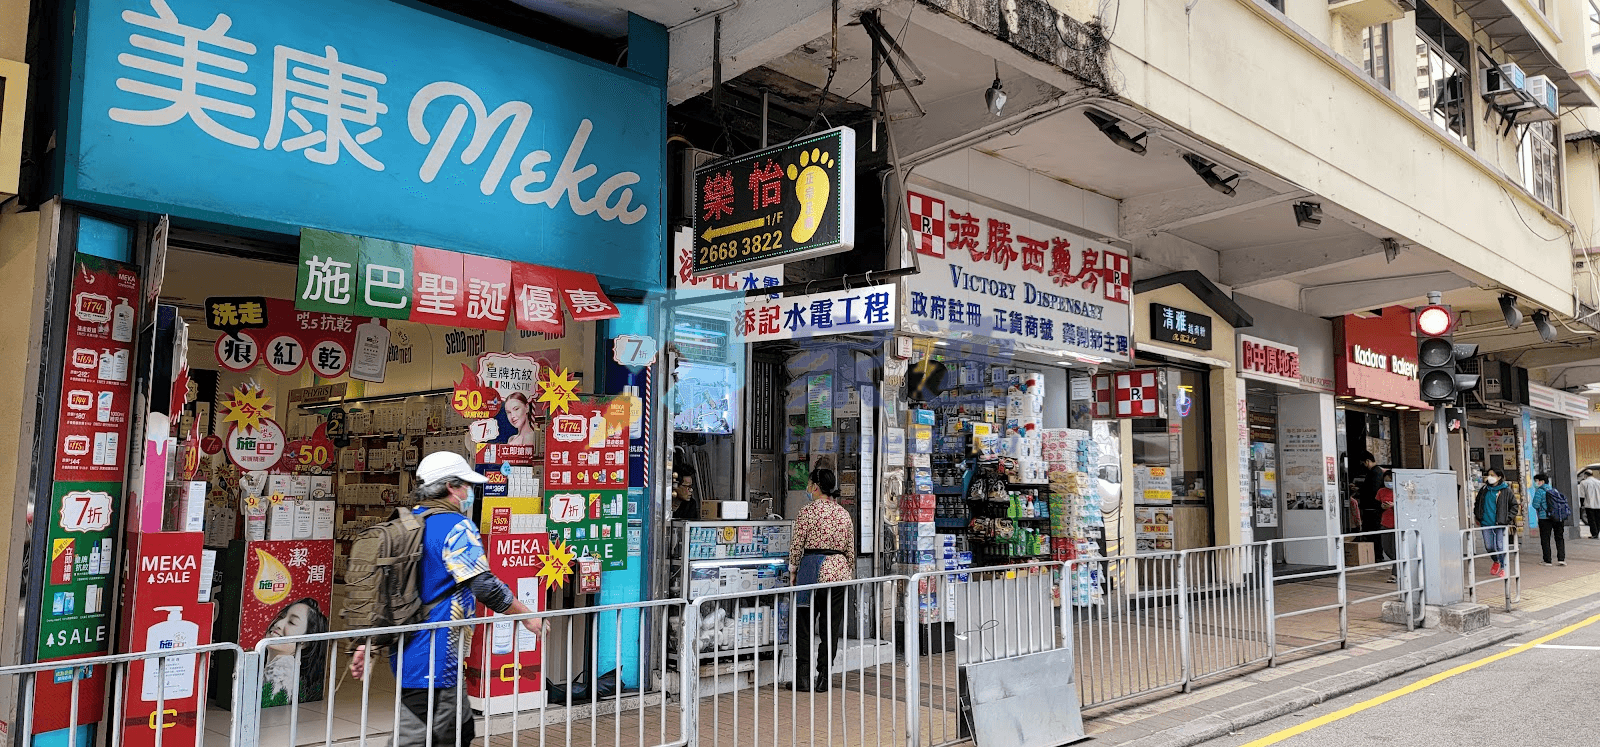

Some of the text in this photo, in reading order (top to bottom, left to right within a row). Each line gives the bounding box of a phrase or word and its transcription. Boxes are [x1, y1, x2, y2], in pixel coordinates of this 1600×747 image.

[108, 0, 647, 225] 美康 Meka
[703, 158, 784, 221] 樂怡
[765, 211, 784, 227] 1/F
[699, 230, 783, 265] 2668 3822
[946, 210, 1104, 293] 德勝西藥房
[302, 255, 612, 325] 施巴聖誕優惠
[211, 302, 264, 326] 洗走
[734, 292, 890, 337] 添記水電工程
[911, 291, 982, 327] 政府註冊
[301, 318, 318, 329] 5.5
[320, 314, 352, 333] 抗乾
[487, 367, 532, 381] 皇牌抗紋
[236, 437, 275, 455] 施巴
[75, 497, 102, 526] 7折
[559, 498, 579, 518] 7折
[497, 539, 540, 555] MEKA
[141, 555, 197, 572] MEKA
[509, 555, 535, 567] SALE
[157, 572, 191, 584] SALE
[57, 626, 106, 647] SALE
